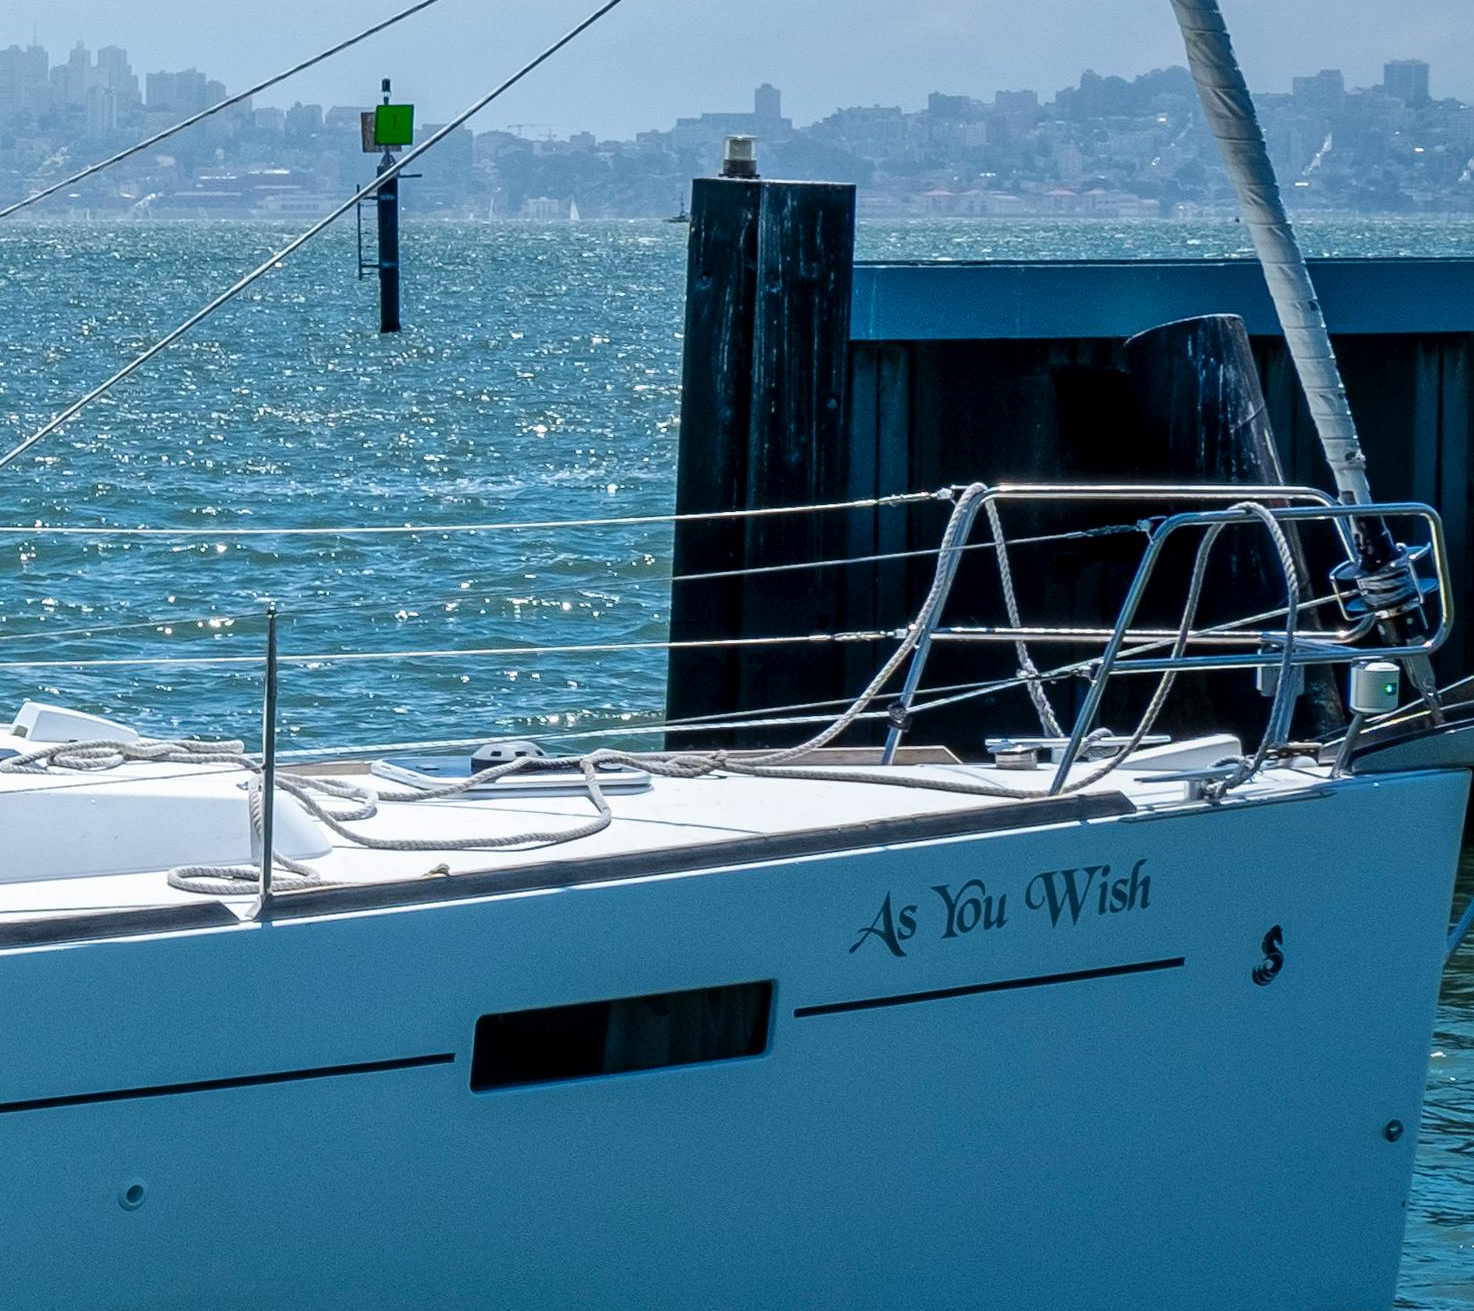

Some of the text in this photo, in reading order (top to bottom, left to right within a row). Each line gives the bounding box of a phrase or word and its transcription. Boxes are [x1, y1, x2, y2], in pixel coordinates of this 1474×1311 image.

[848, 858, 1152, 957] As You Wish
